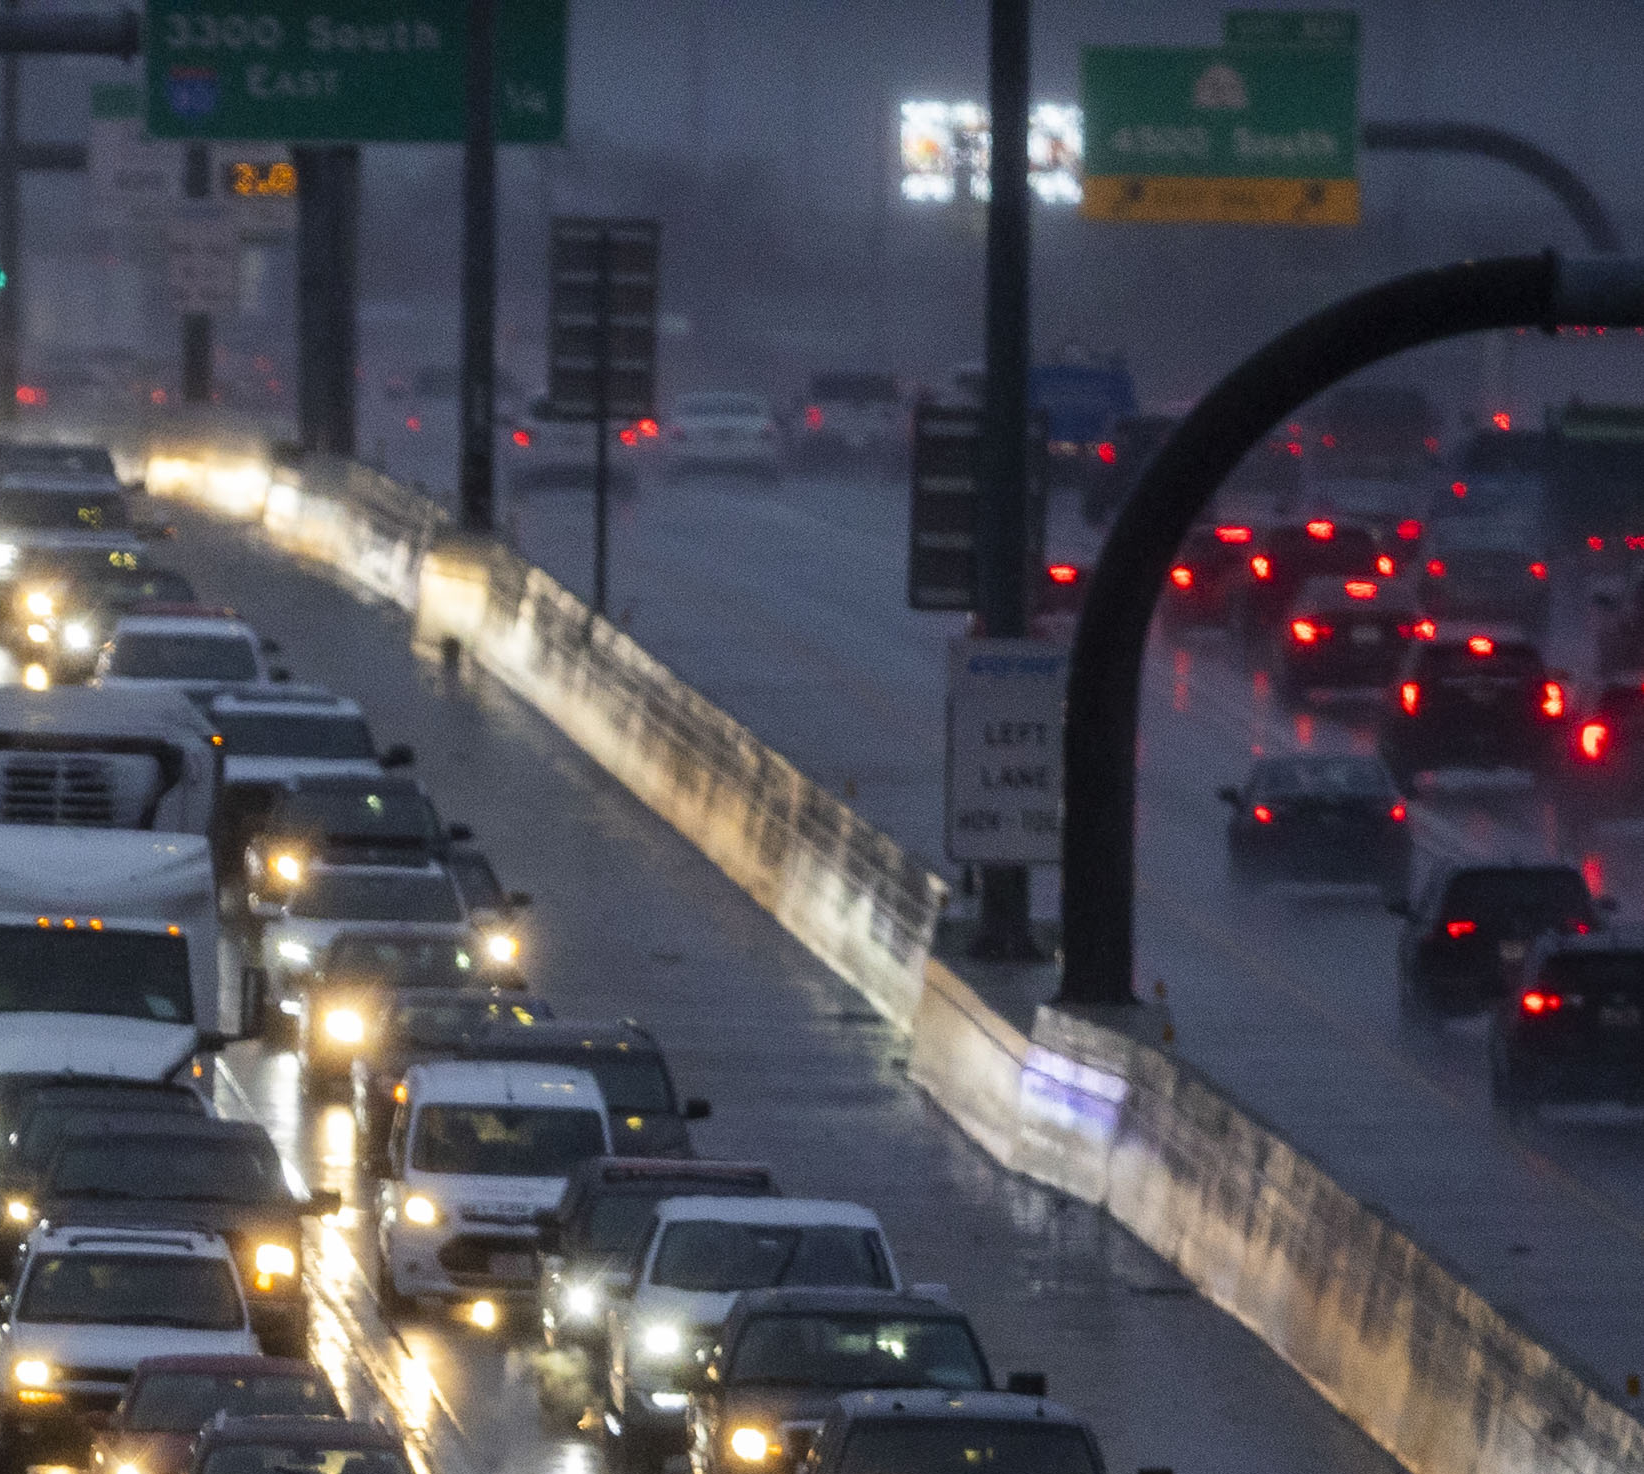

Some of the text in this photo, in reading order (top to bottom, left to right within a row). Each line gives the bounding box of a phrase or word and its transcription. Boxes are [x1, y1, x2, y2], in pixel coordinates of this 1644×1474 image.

[165, 14, 442, 51] 3300 South
[246, 64, 341, 98] EAST
[983, 720, 1047, 747] LEFT
